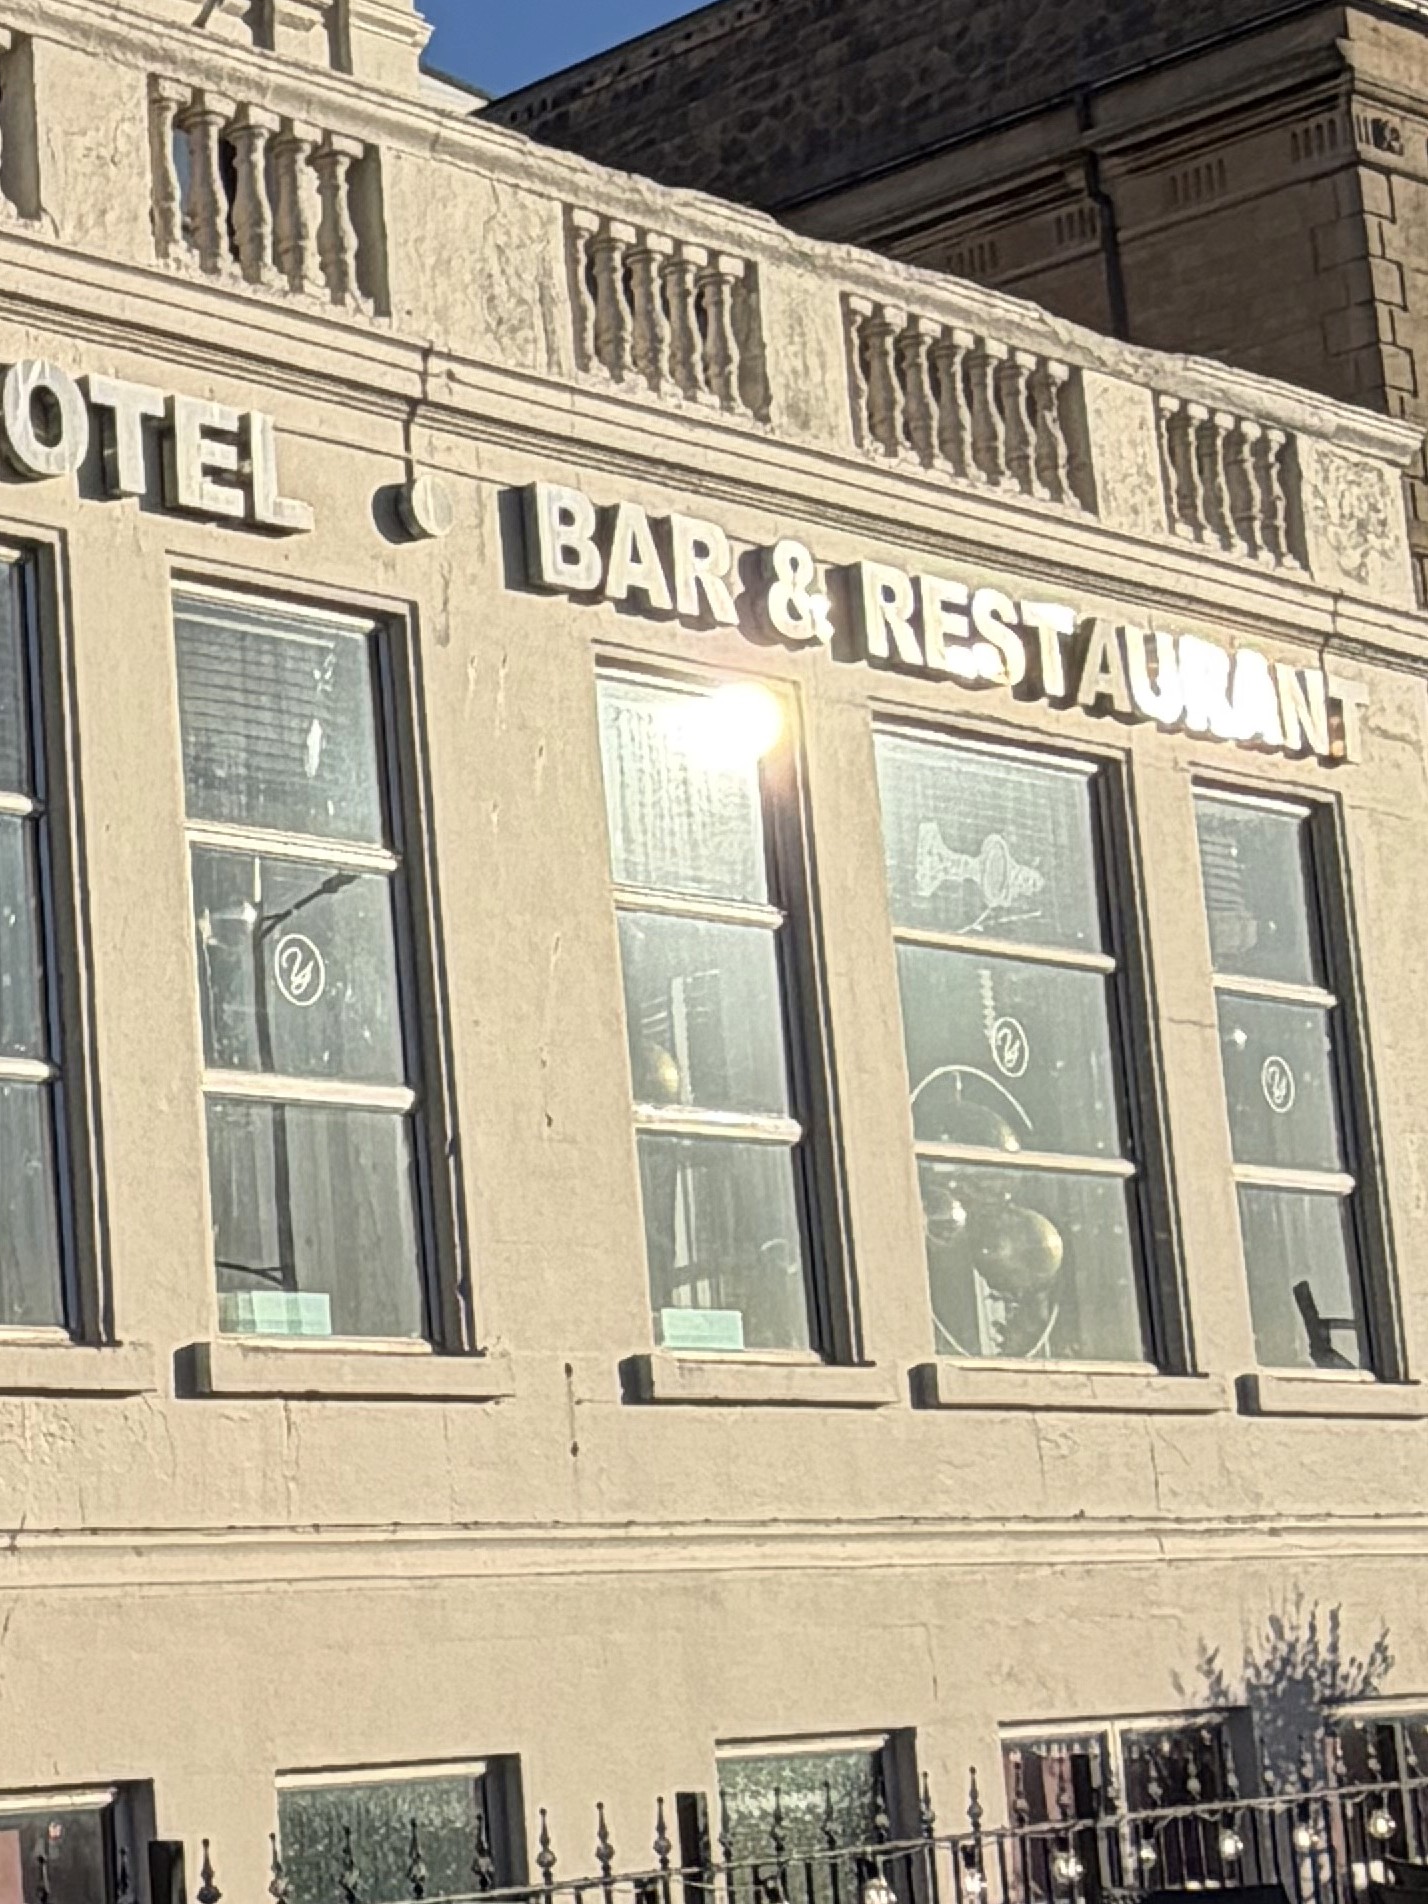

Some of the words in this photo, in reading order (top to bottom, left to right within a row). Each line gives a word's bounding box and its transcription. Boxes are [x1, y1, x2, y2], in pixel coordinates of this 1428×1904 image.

[535, 481, 739, 627] BAR
[769, 538, 835, 647] &
[859, 559, 1370, 764] RESTAURANT
